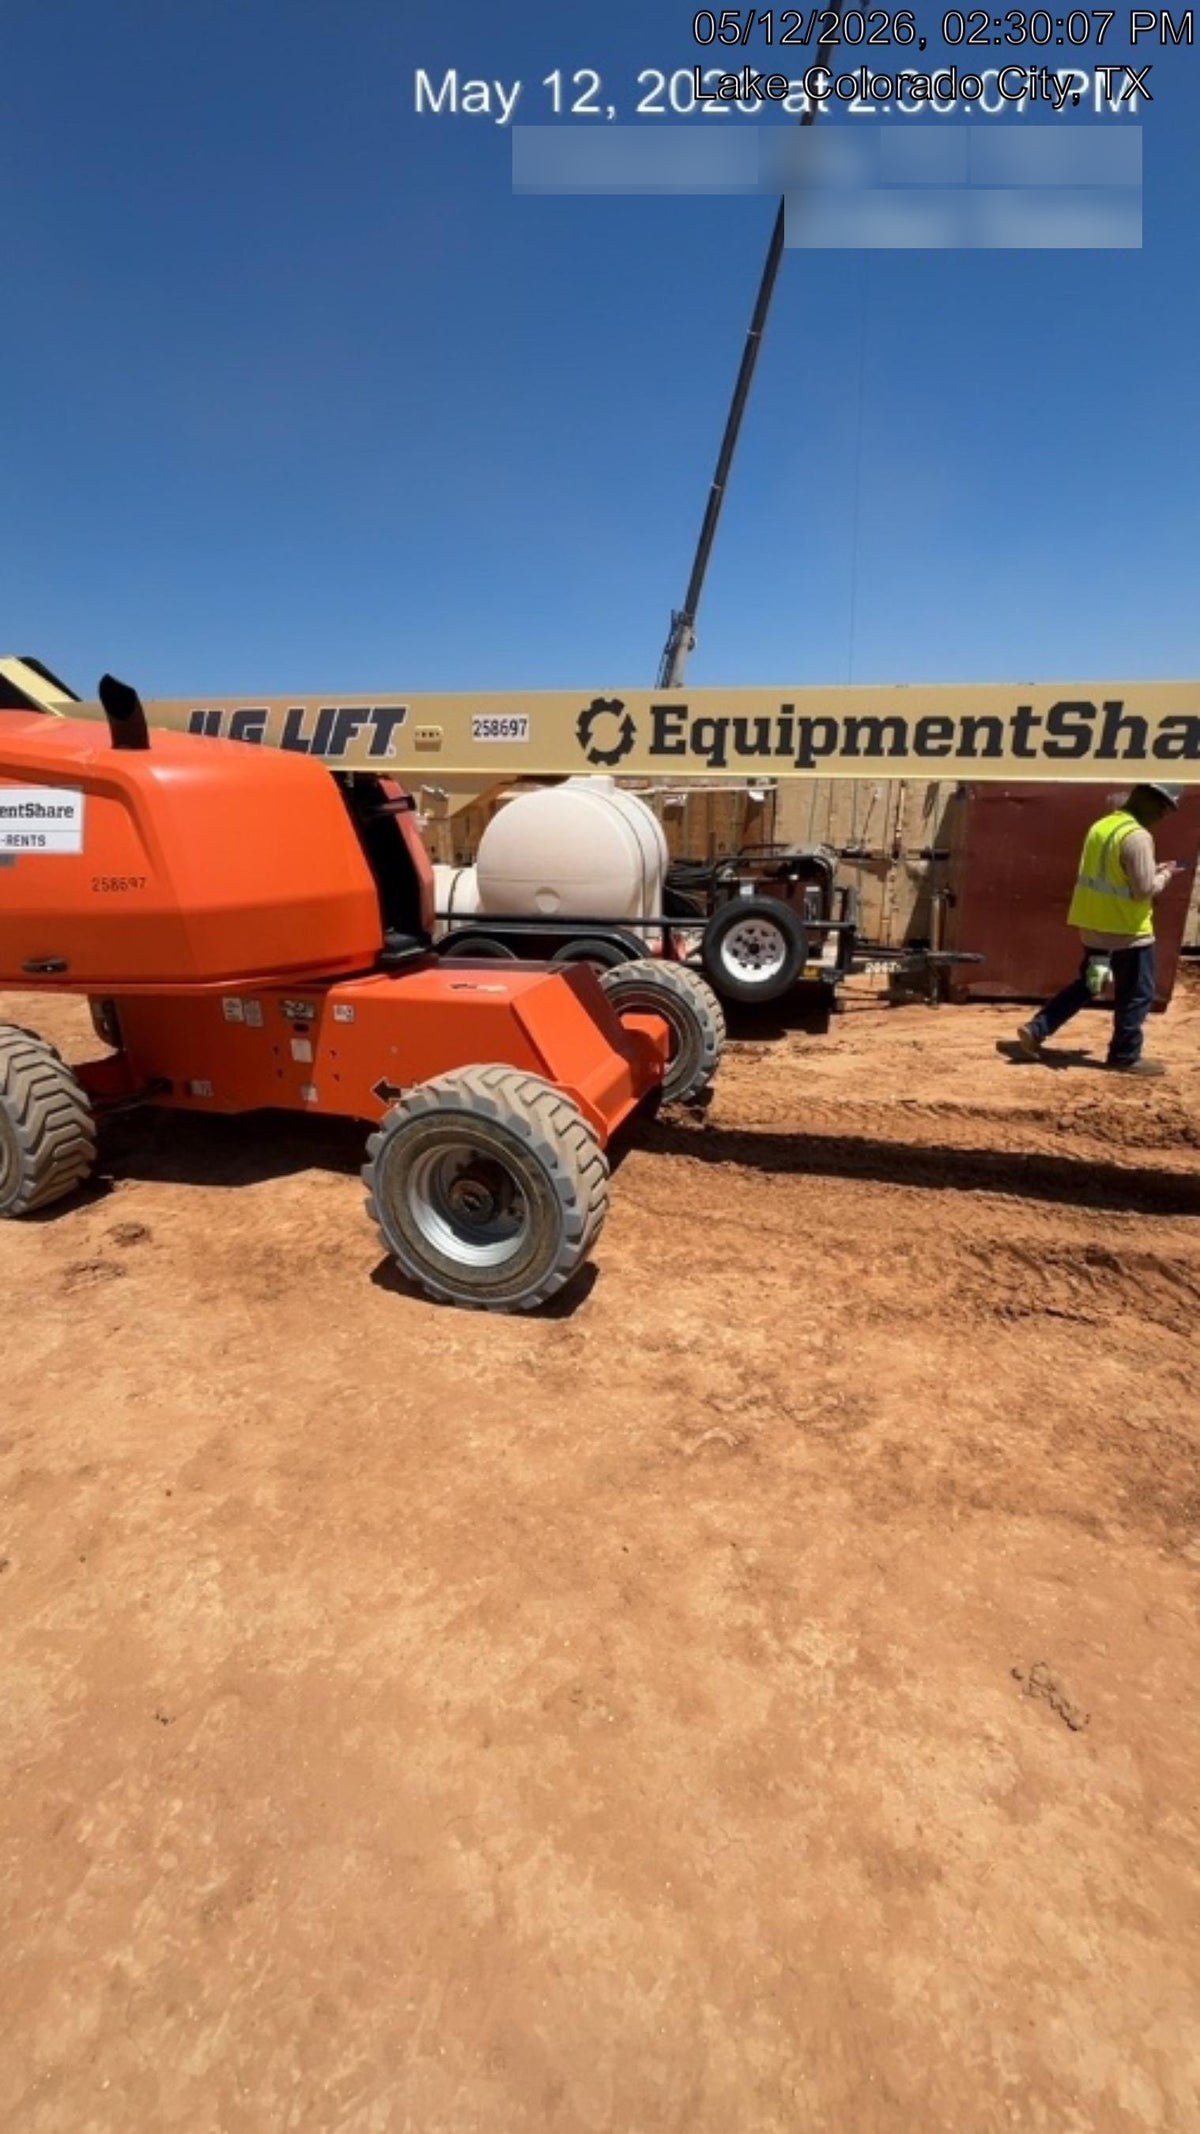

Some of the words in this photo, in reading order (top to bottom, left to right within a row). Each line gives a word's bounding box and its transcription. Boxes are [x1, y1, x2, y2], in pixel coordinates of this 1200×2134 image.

[279, 706, 408, 757] LIFT
[472, 717, 528, 738] 258697
[649, 700, 1200, 769] EquipmentSha
